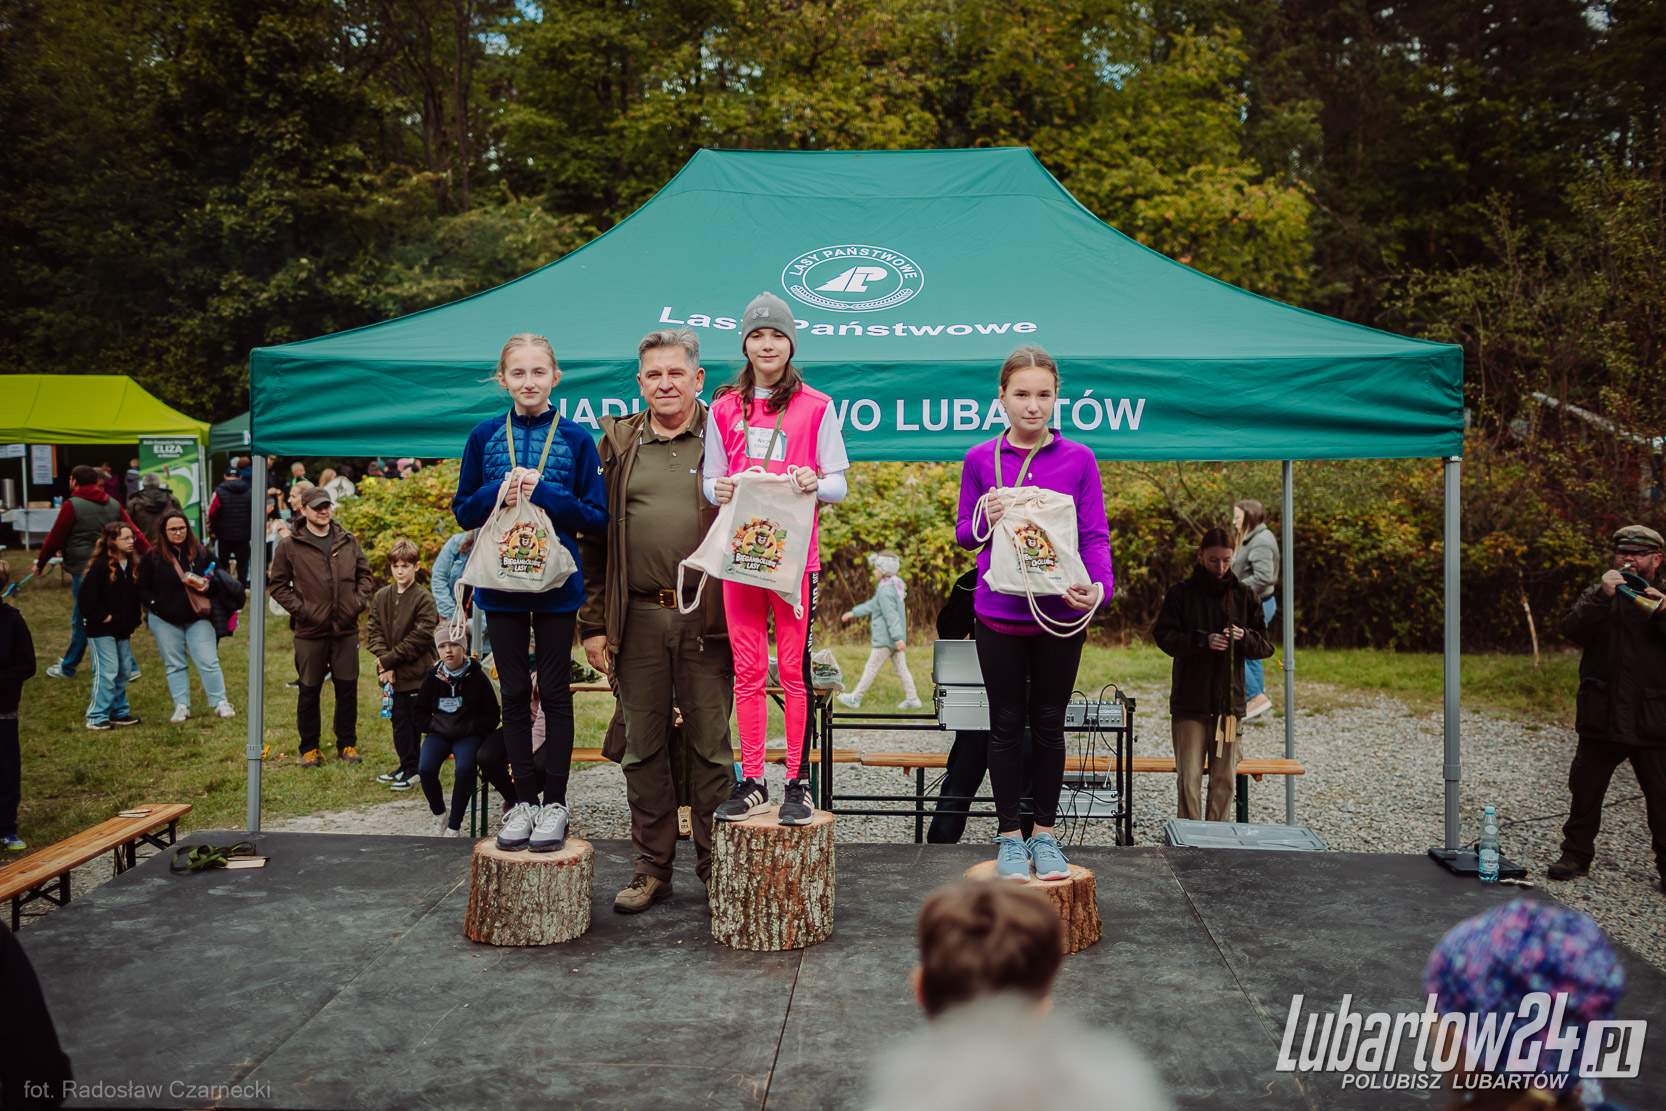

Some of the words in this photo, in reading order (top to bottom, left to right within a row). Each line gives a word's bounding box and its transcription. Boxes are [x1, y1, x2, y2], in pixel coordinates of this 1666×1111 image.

[789, 254, 821, 276] LASY
[823, 247, 918, 279] PAŃSTWOWE
[659, 306, 744, 335] Las
[896, 390, 1146, 431] LUBATÓW
[153, 445, 183, 454] ELIZA
